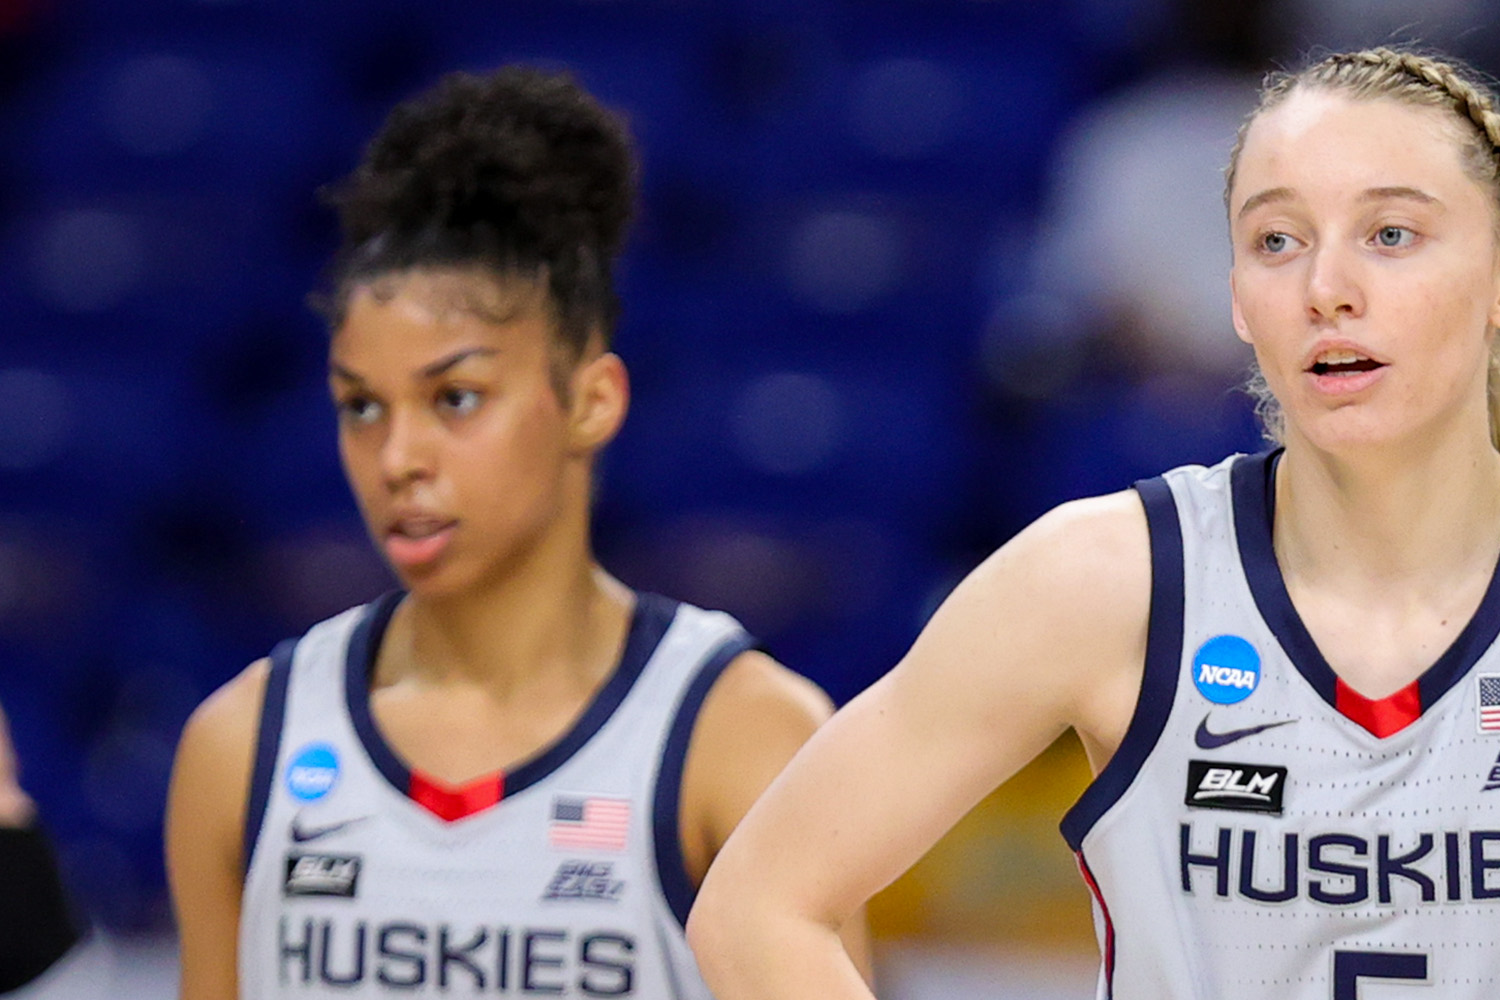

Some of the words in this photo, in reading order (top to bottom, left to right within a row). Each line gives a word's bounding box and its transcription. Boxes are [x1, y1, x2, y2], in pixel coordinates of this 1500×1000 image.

[1199, 664, 1257, 690] NCAA
[1198, 767, 1279, 794] BLM
[279, 917, 637, 998] HUSKIES
